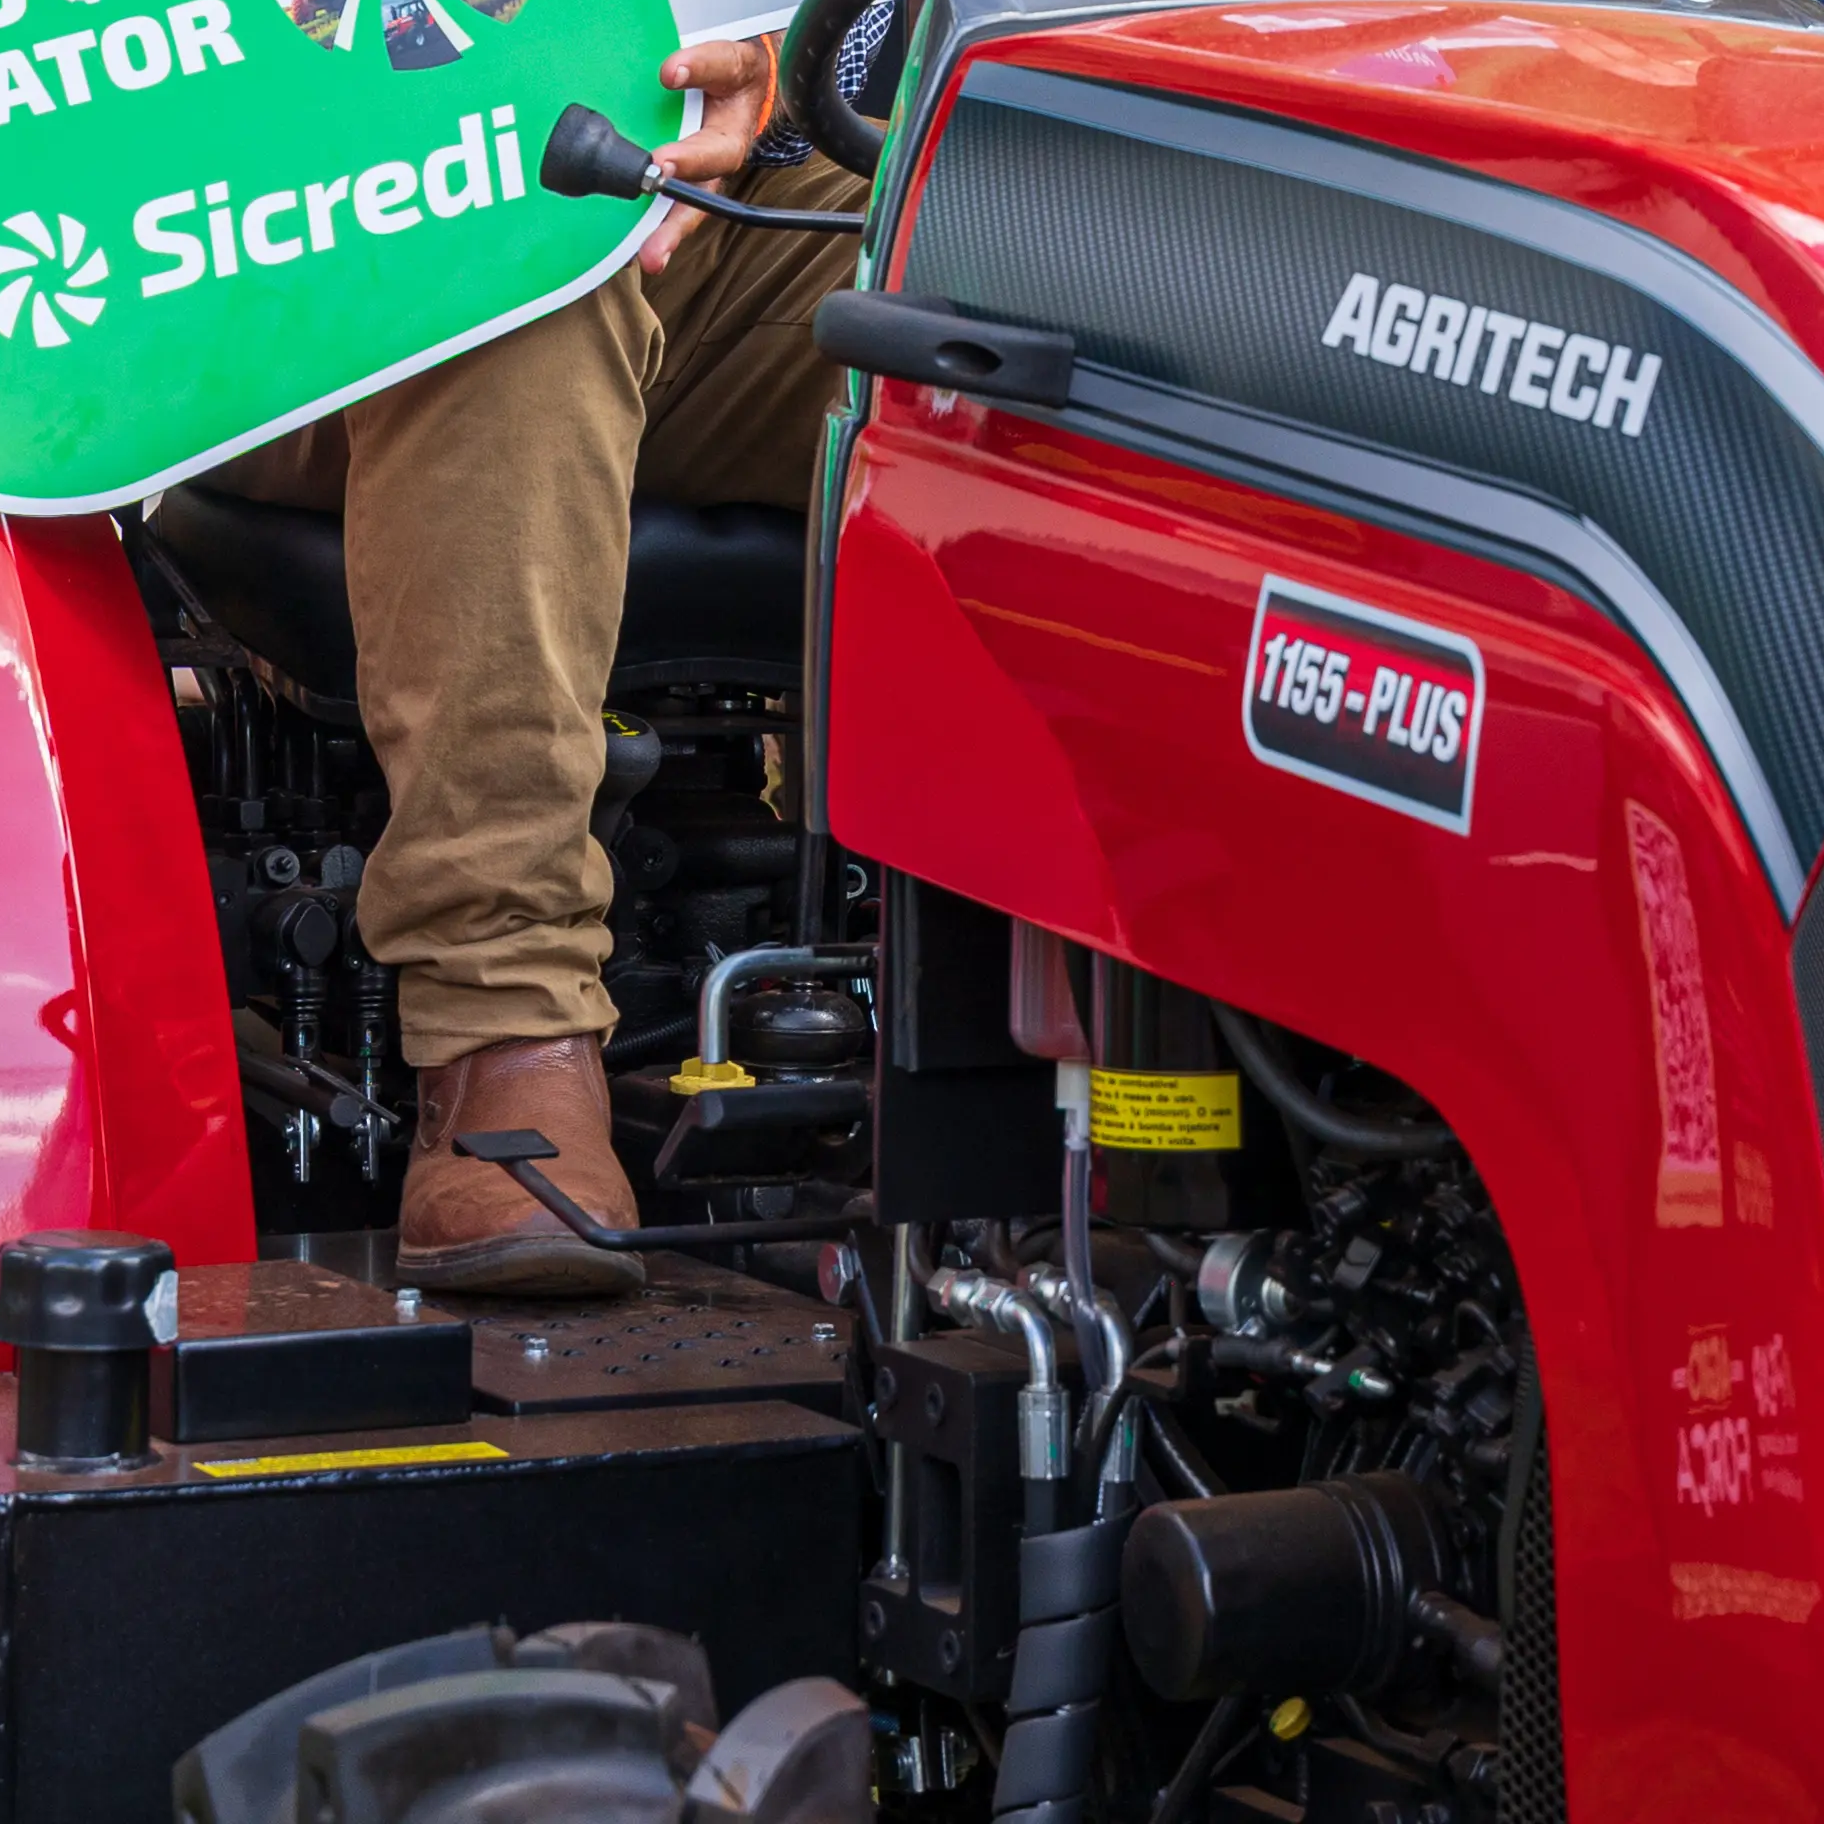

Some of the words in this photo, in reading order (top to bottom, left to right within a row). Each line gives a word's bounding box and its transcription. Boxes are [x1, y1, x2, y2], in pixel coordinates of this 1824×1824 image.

[133, 103, 527, 300] Sicredi
[1322, 272, 1662, 437] AGRITECH
[1258, 632, 1468, 764] 1155-PLUS
